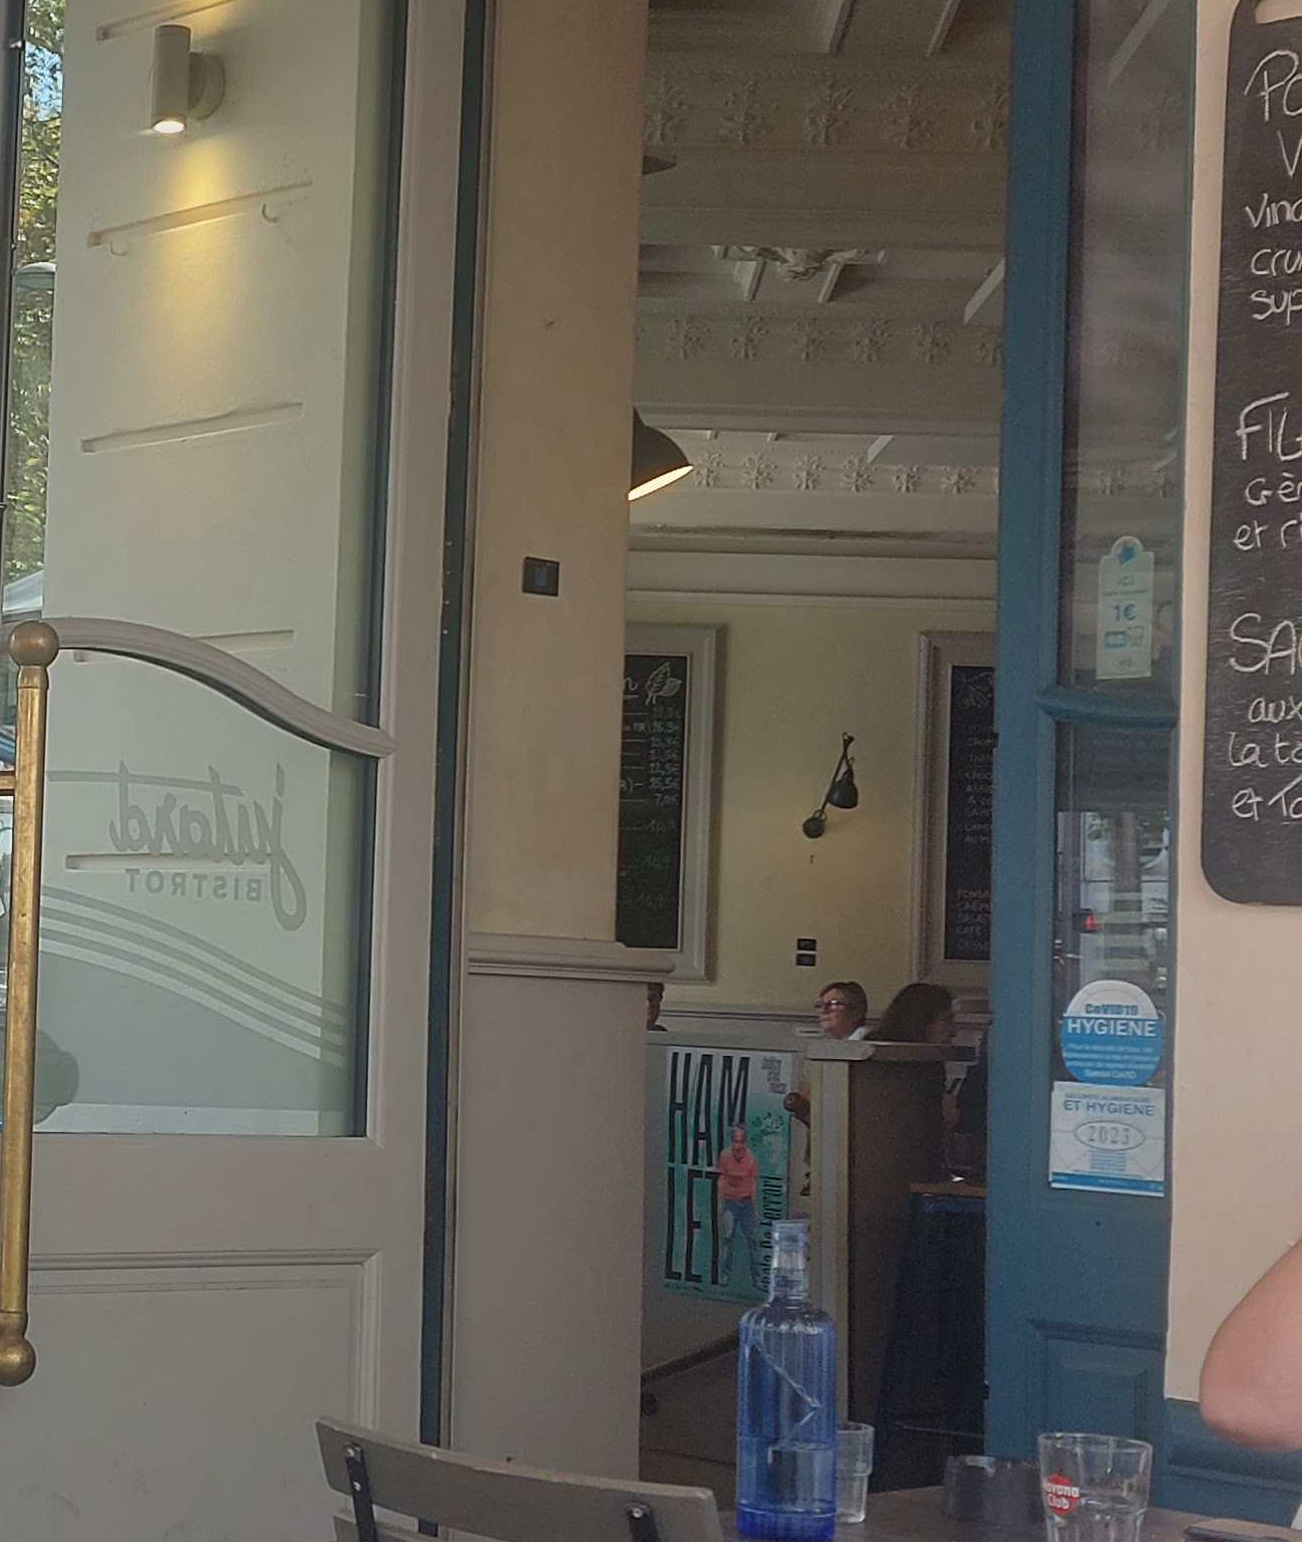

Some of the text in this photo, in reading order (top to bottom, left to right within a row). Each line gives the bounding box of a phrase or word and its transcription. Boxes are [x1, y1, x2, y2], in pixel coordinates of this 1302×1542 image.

[1114, 603, 1136, 622] 1€
[1228, 613, 1302, 676] SA
[1067, 1018, 1157, 1037] HYGIENE
[668, 1051, 751, 1167] HAM
[1064, 1099, 1156, 1117] ET HYGIENE
[1088, 1125, 1130, 1146] 2023
[665, 1166, 724, 1287] LET
